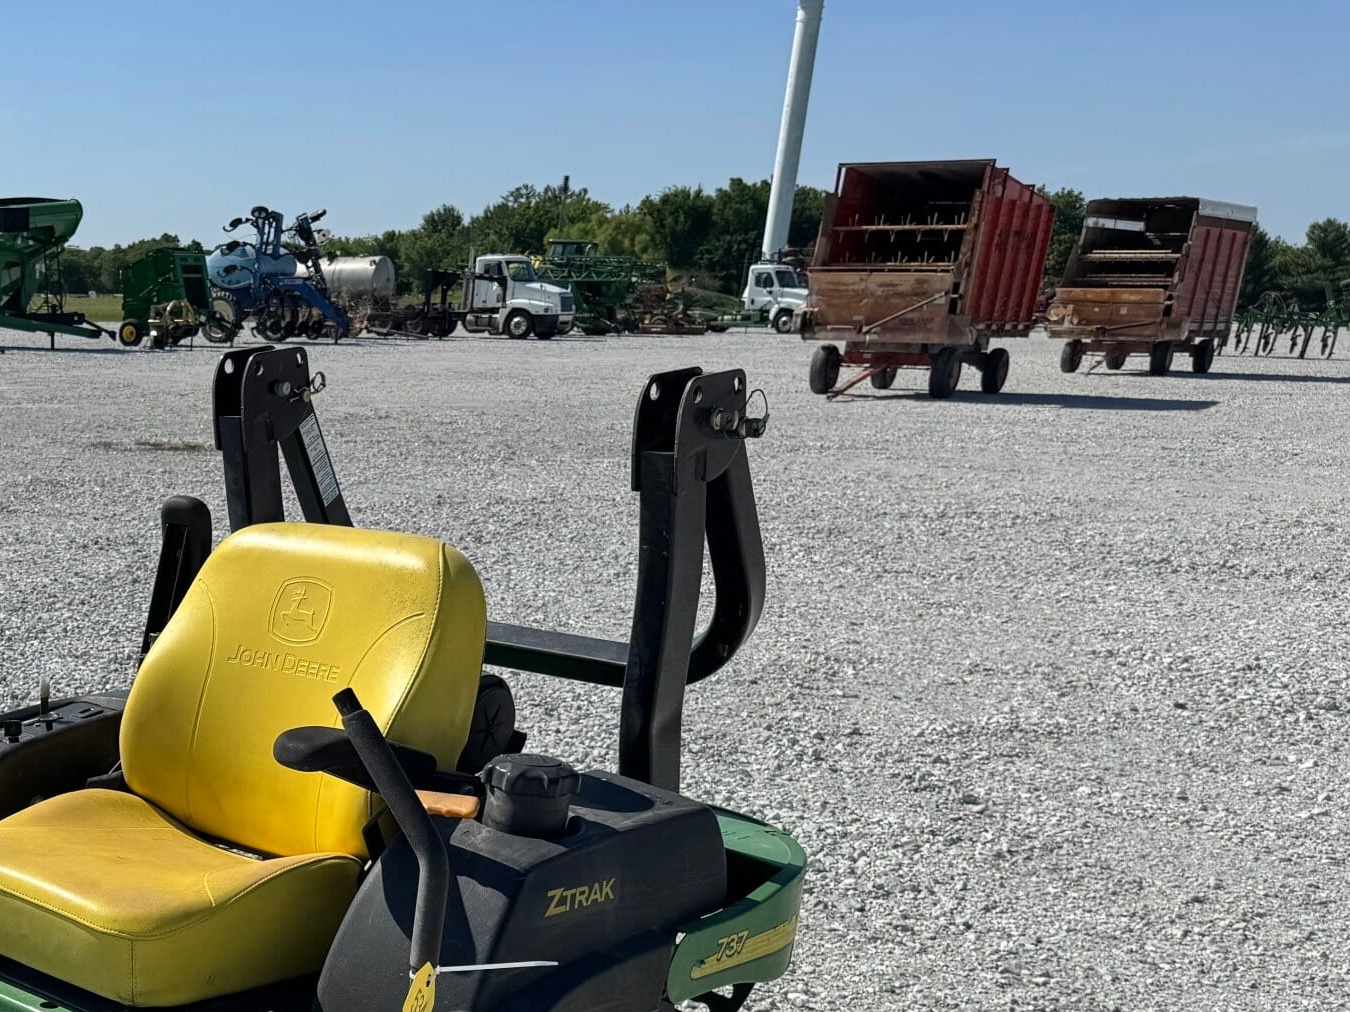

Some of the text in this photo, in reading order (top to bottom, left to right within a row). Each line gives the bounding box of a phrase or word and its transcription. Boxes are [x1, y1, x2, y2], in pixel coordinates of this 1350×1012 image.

[227, 644, 341, 683] JOHN DEERE
[545, 878, 616, 917] ZTRAK
[716, 930, 749, 961] 737
